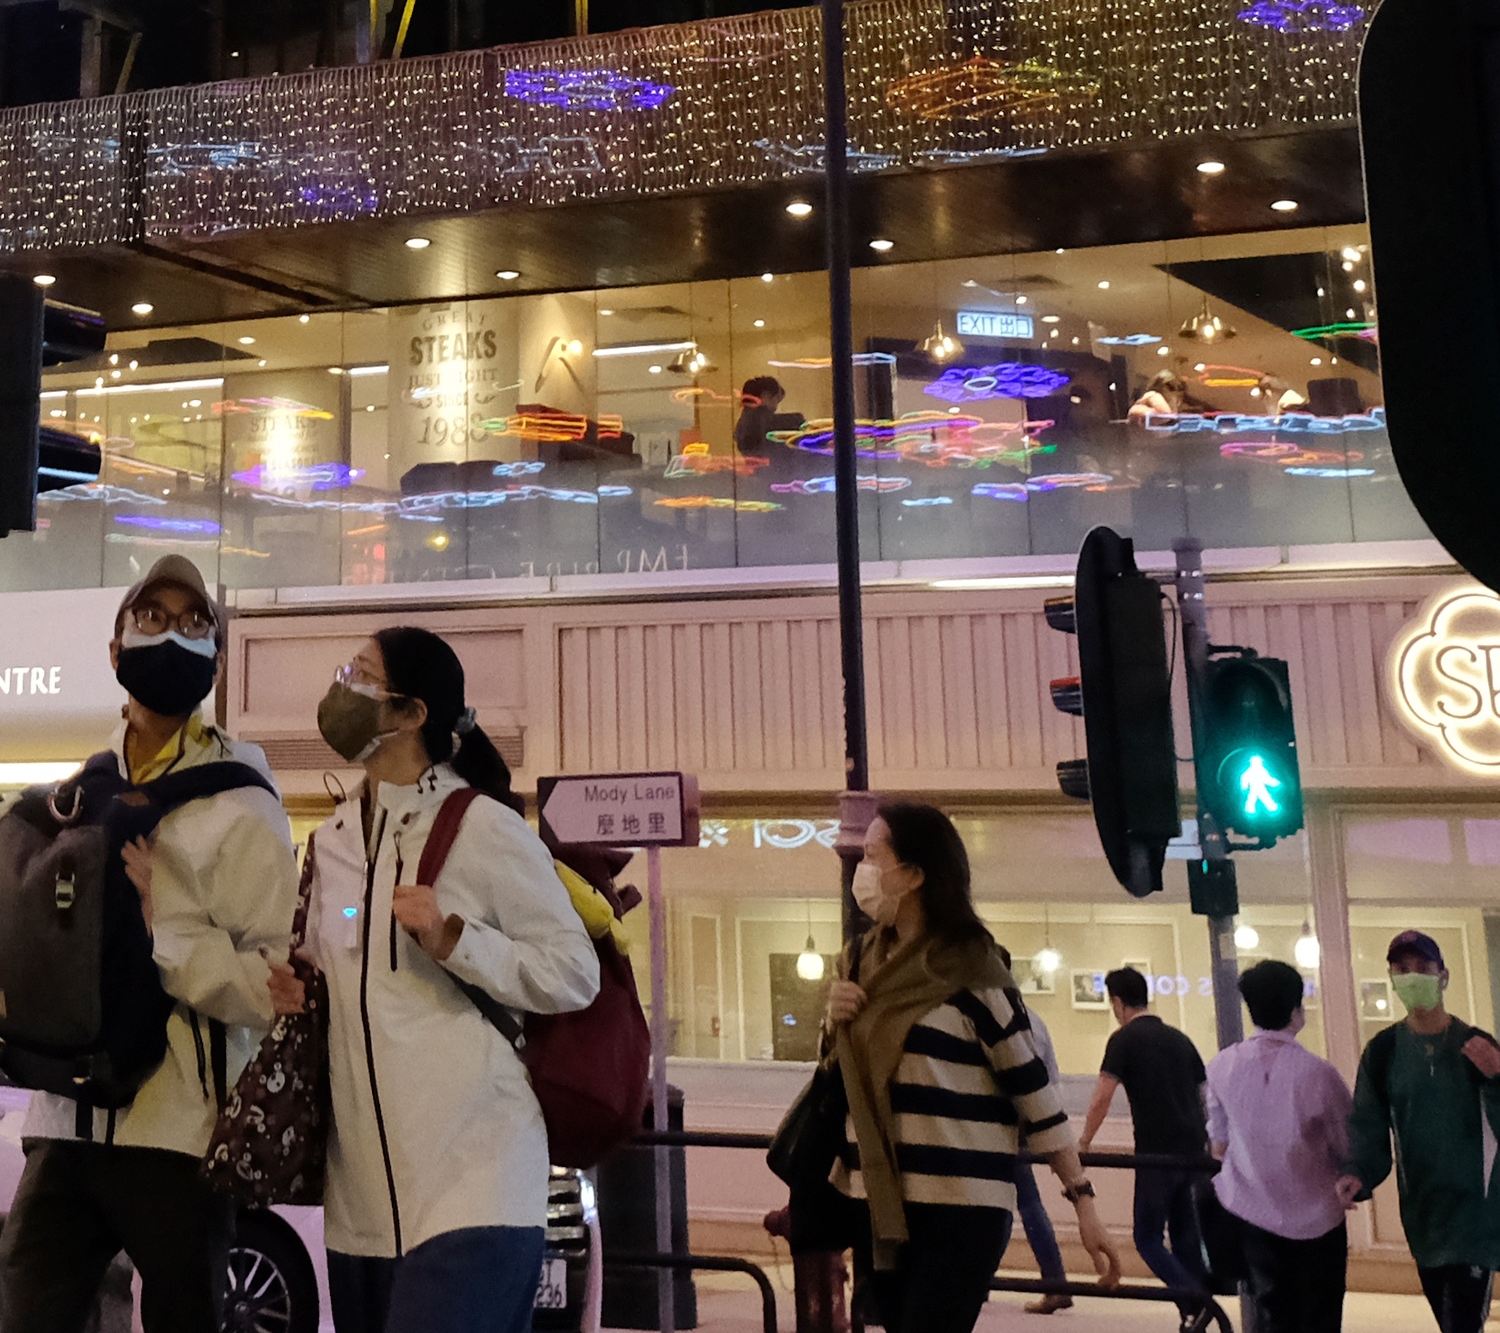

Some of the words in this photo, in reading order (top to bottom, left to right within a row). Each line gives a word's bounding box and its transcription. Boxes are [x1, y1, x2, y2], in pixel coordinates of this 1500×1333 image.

[960, 314, 997, 334] EXIT
[1000, 317, 1031, 337] 出口
[409, 329, 498, 367] STEAKS
[585, 784, 628, 805] Mody
[634, 784, 676, 801] Lane
